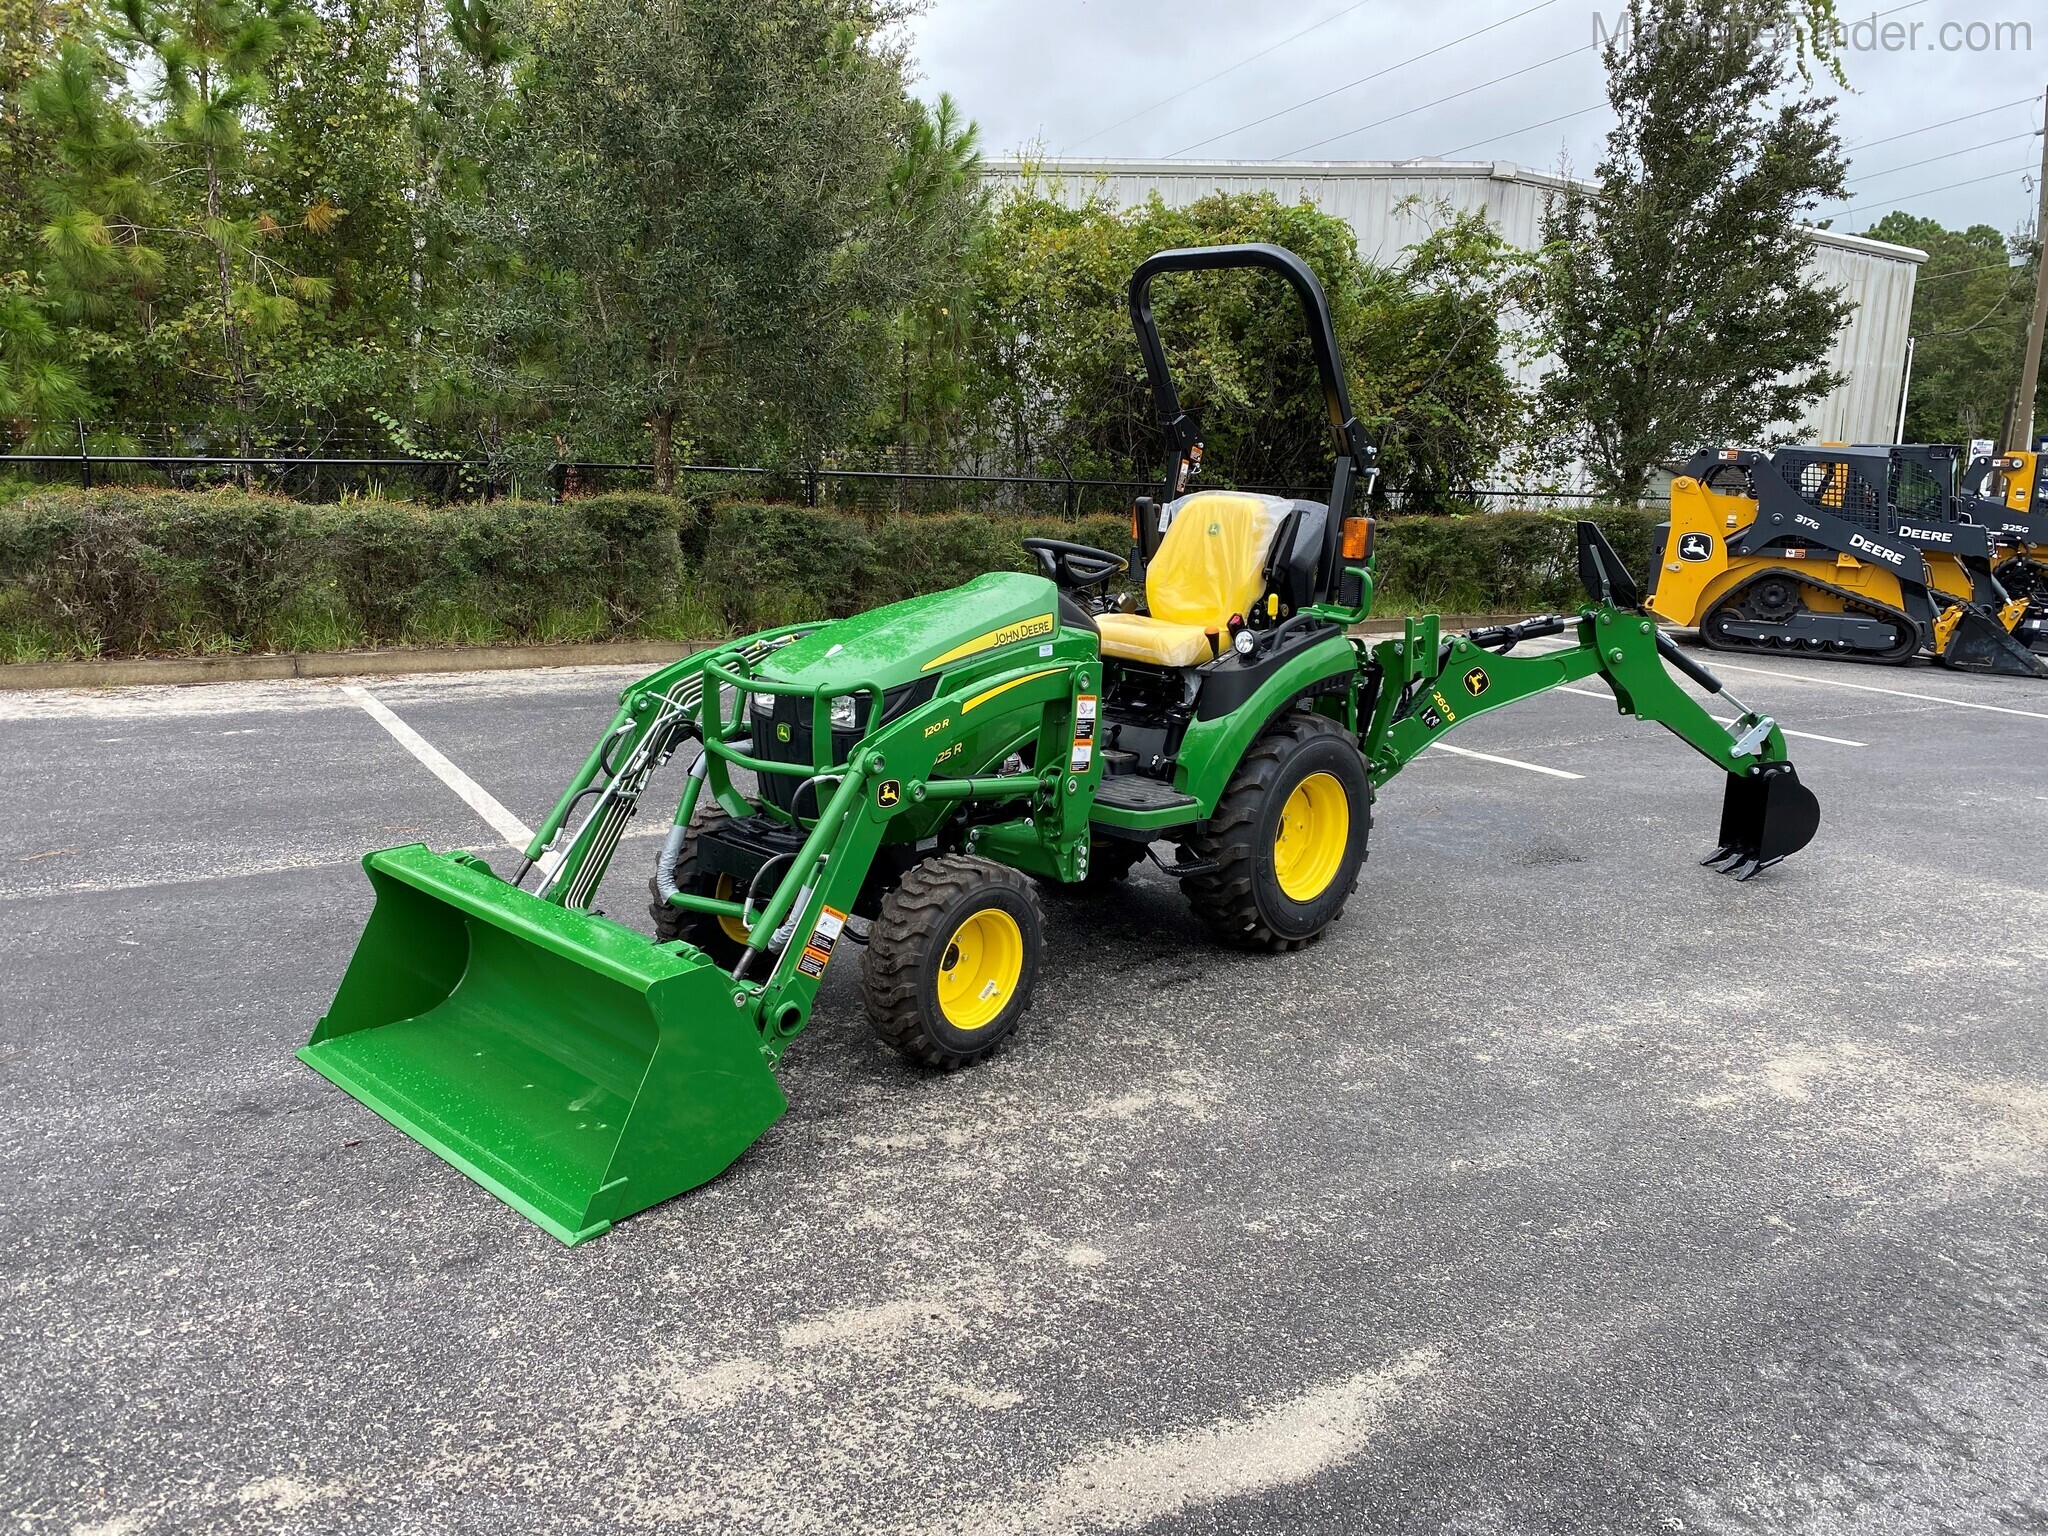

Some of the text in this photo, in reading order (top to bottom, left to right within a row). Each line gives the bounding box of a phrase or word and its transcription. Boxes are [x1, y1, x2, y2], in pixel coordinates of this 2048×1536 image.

[1794, 514, 1821, 530] 317G
[2001, 523, 2030, 533] 325G
[1899, 525, 1954, 543] DEERE
[1849, 533, 1906, 565] DEERE
[994, 621, 1050, 646] JOHN DEERE
[1433, 691, 1456, 722] 260 B
[924, 718, 950, 739] 120 R
[933, 742, 963, 766] 25 R
